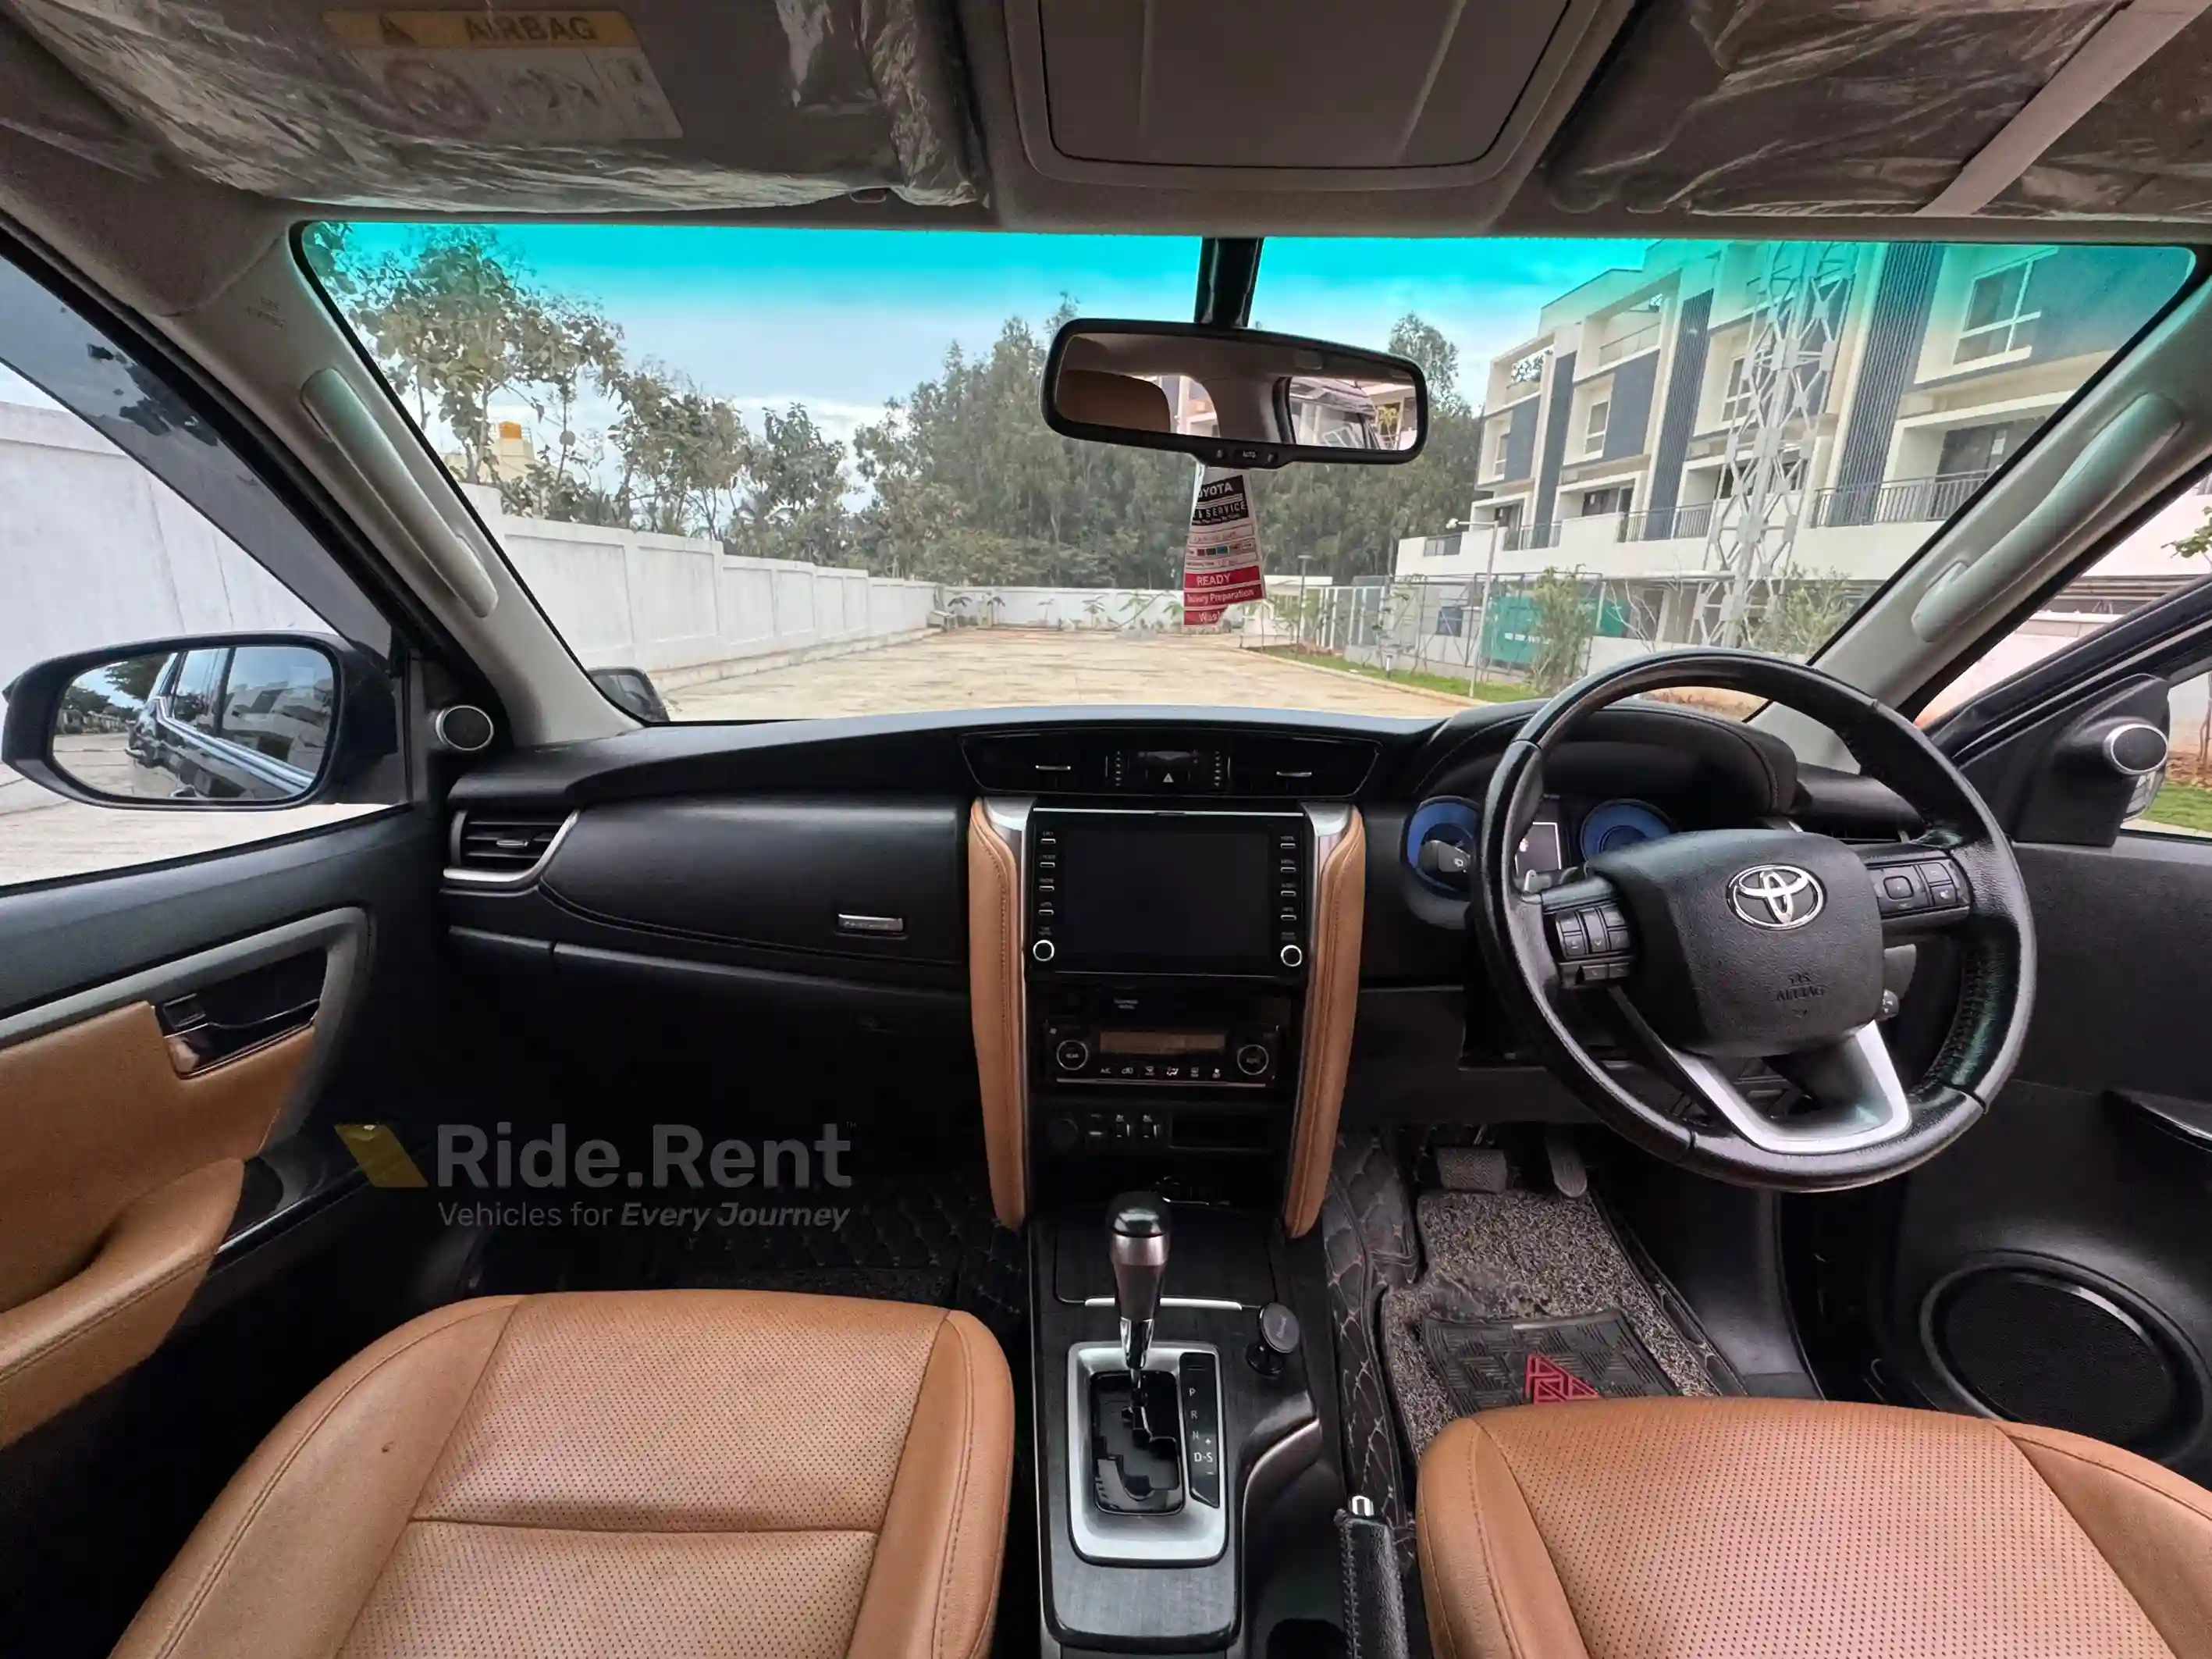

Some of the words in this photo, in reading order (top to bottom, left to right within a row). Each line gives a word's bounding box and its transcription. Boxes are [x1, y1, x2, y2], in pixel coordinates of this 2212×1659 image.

[462, 14, 599, 41] AIRBAG
[1205, 500, 1246, 518] SERVICE
[1197, 573, 1231, 586] READY
[1210, 589, 1254, 603] Preparation
[1189, 1388, 1196, 1397] P
[1190, 1410, 1197, 1419] R
[1192, 1431, 1200, 1440] N
